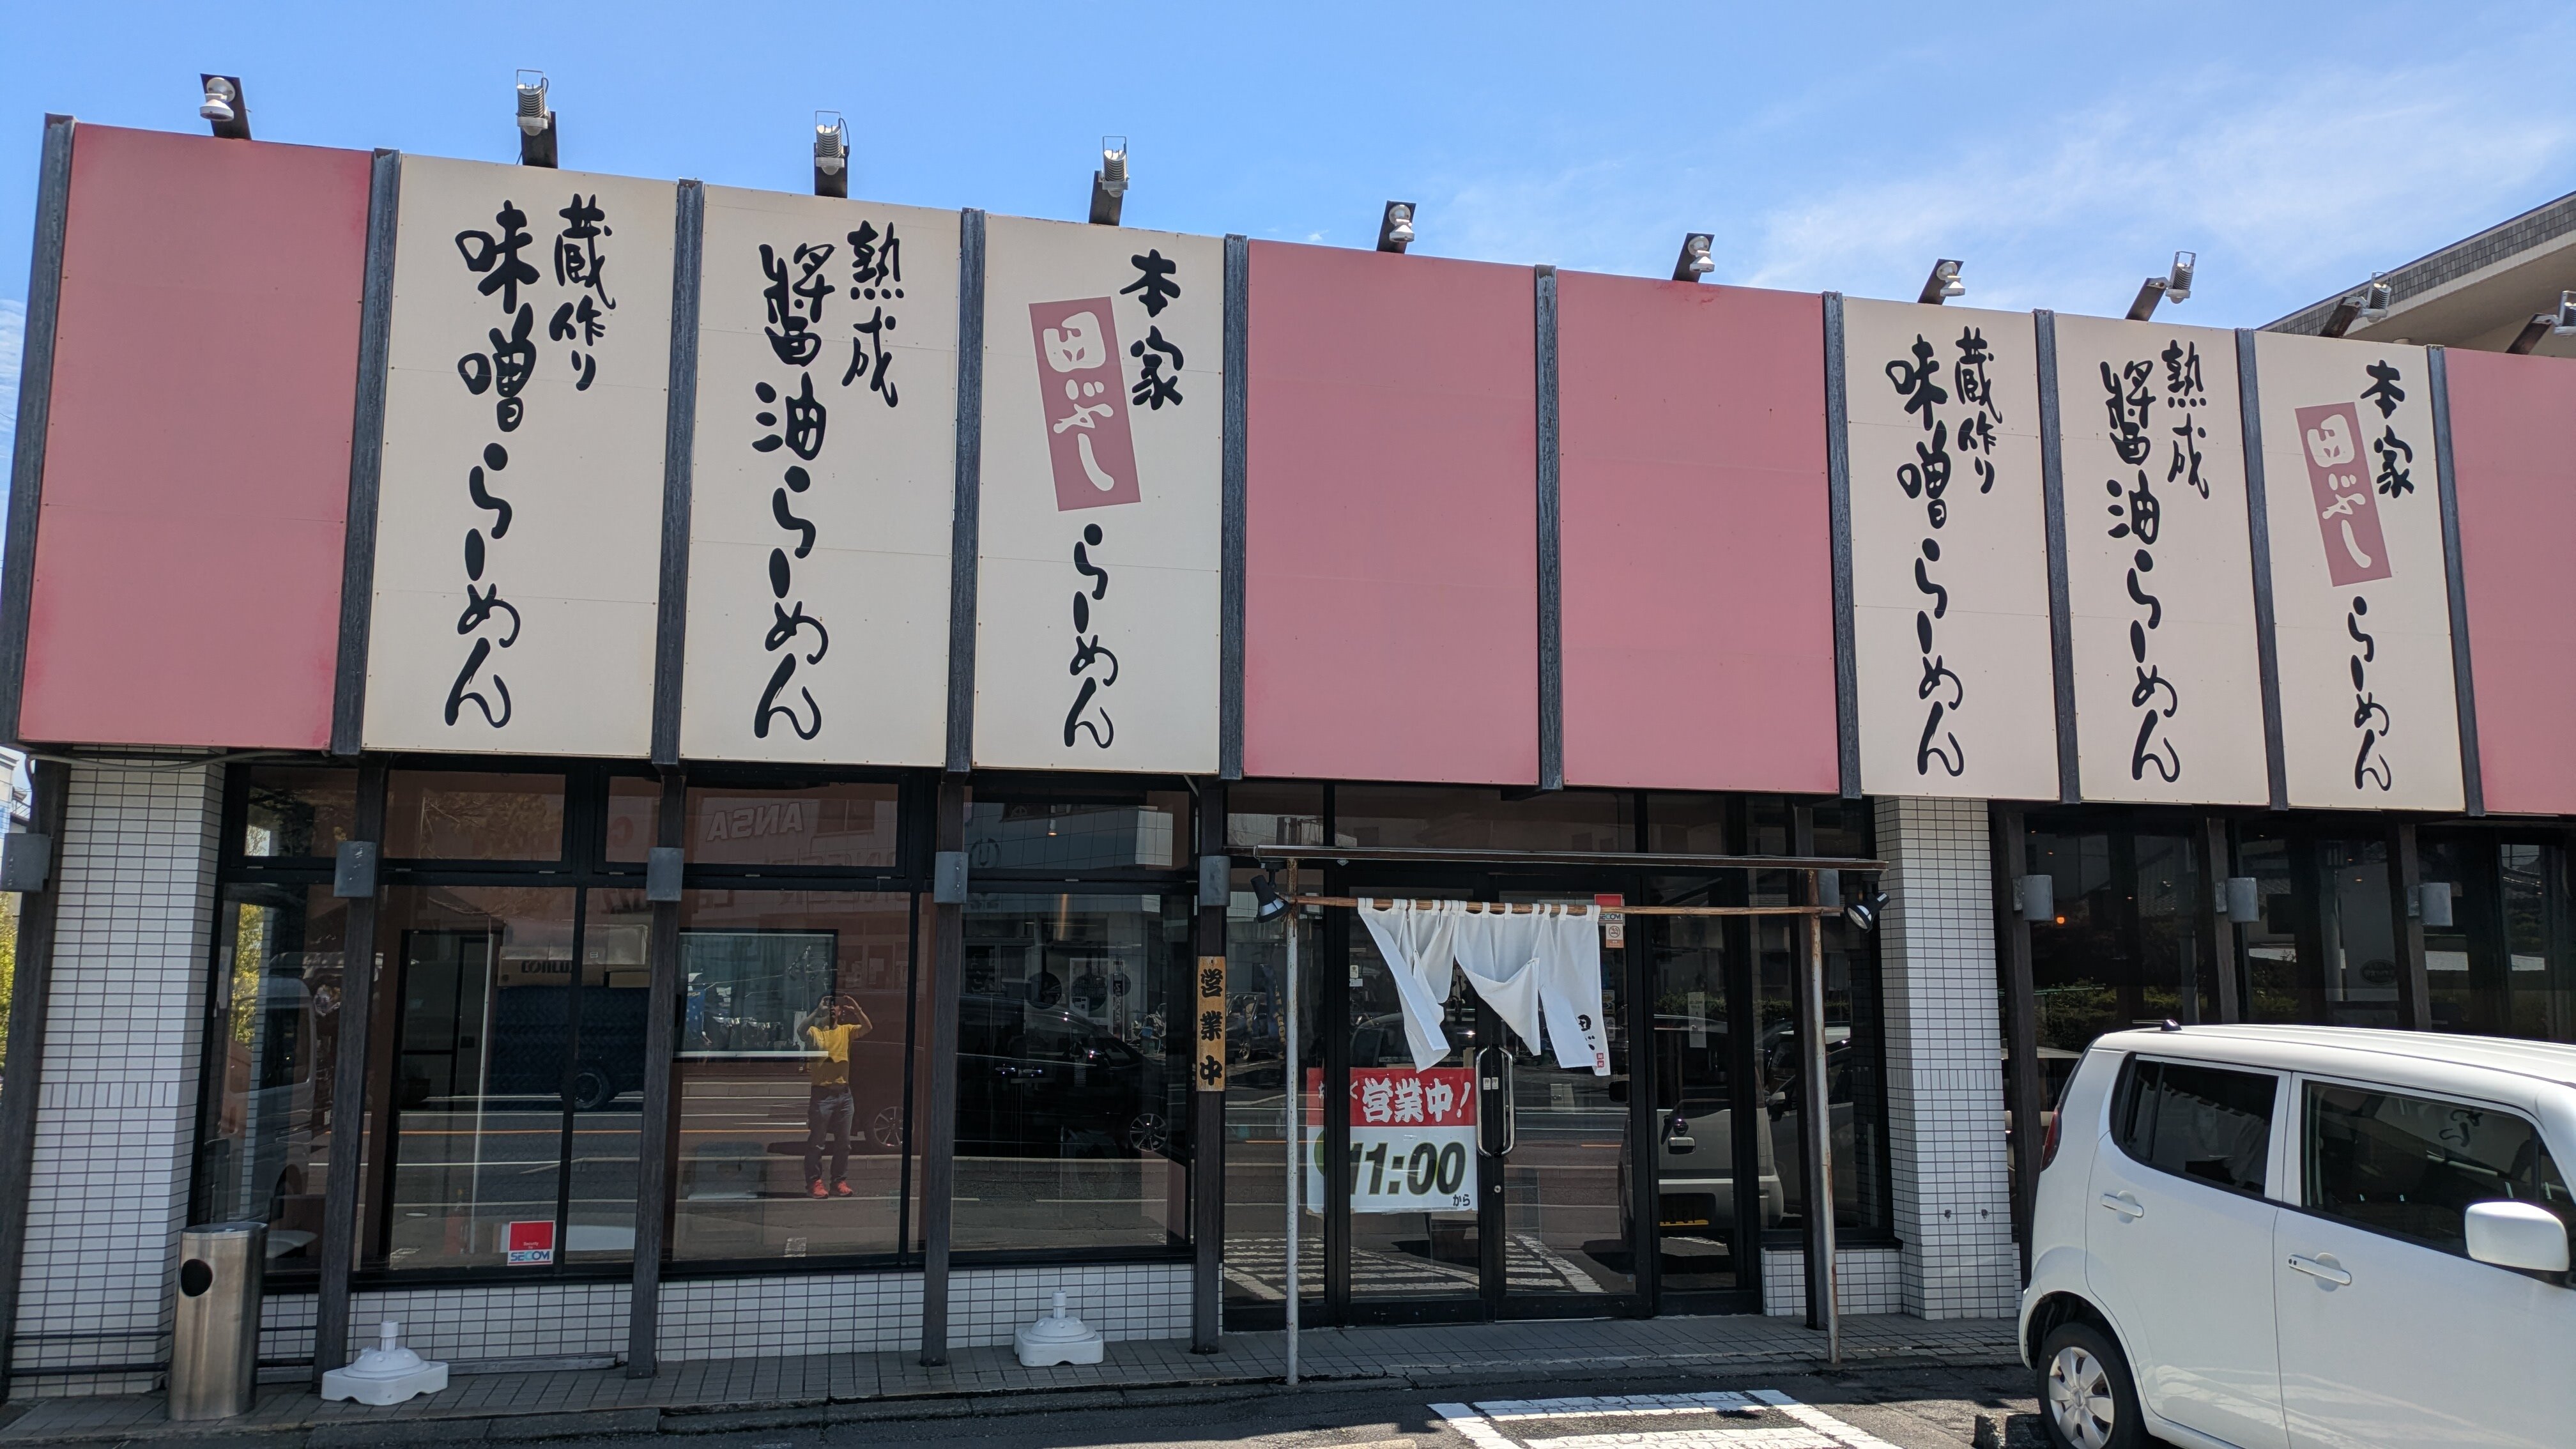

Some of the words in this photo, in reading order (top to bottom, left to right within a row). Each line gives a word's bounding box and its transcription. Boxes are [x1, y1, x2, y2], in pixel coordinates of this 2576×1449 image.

[549, 193, 617, 391] 蔵作り
[841, 220, 905, 408] 熟成
[1119, 249, 1184, 411] 本家
[445, 199, 540, 728] 味噌らーめん
[1954, 326, 2003, 494] 蔵作り
[2161, 339, 2210, 500] 熟成
[2360, 360, 2415, 500] 本家
[1064, 523, 1119, 749] らーめん
[1885, 334, 1965, 777] 味噌らーめん
[2347, 596, 2392, 792] らーめん
[521, 960, 572, 973] CONLU
[1199, 968, 1223, 1086] 営業中
[510, 1250, 550, 1261] SECOM
[1350, 1141, 1466, 1196] 11:00
[1453, 1193, 1471, 1207] から
